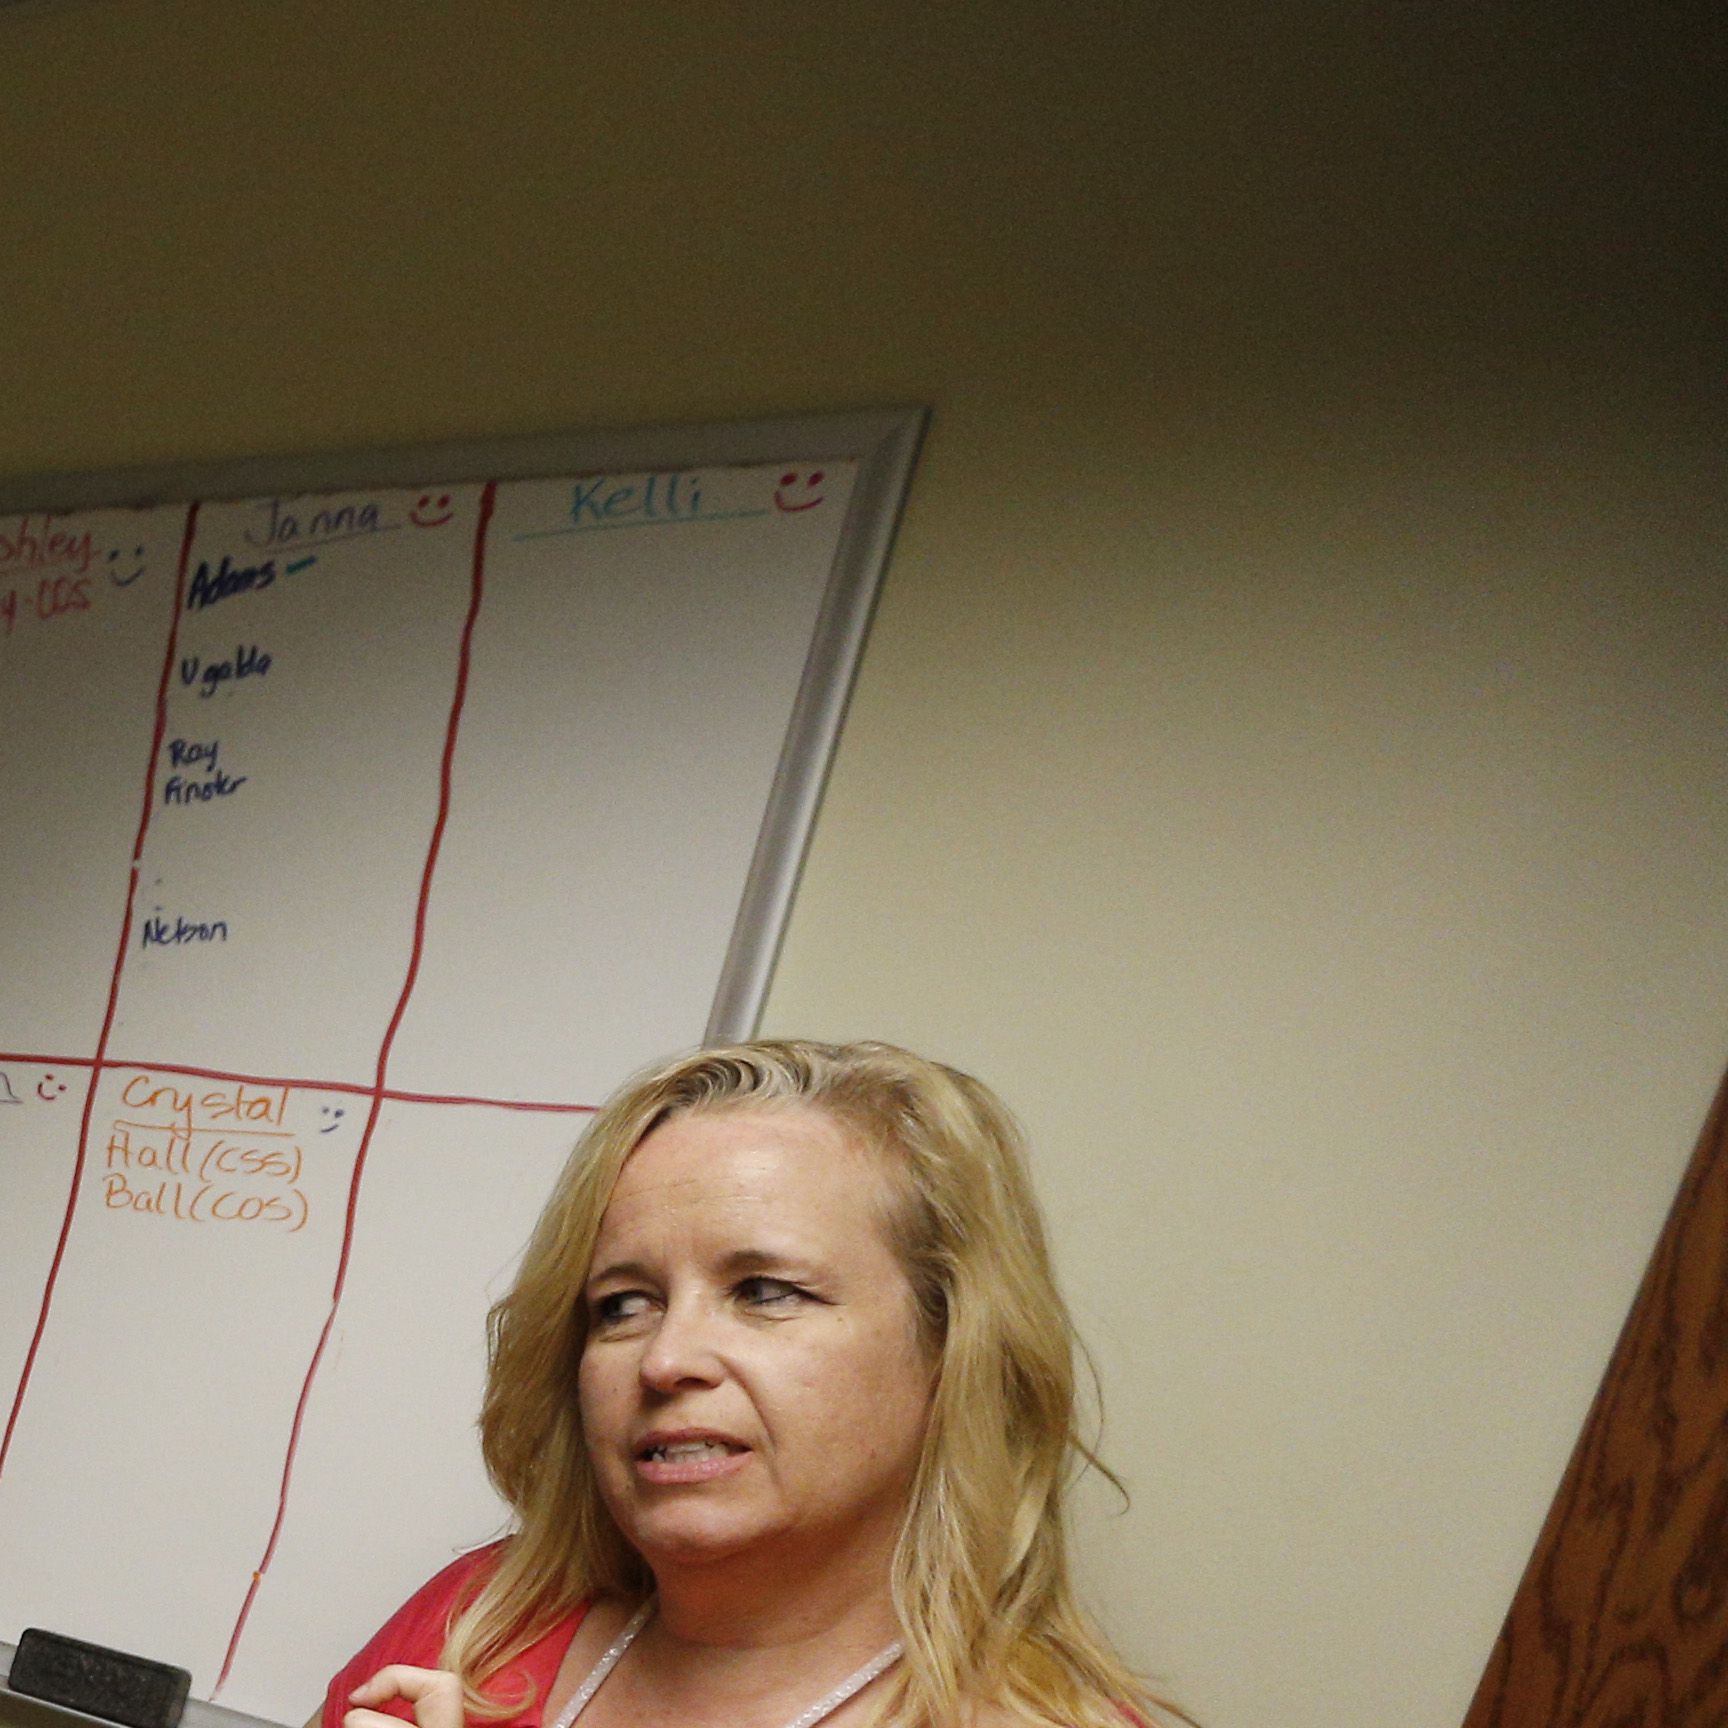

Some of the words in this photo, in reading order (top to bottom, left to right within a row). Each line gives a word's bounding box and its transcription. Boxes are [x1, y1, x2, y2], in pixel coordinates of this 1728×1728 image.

[568, 473, 702, 524] Kelli
[245, 500, 380, 546] Janna
[141, 916, 228, 950] Nelson
[121, 1074, 290, 1141] Crystal
[106, 1130, 192, 1175] Hall
